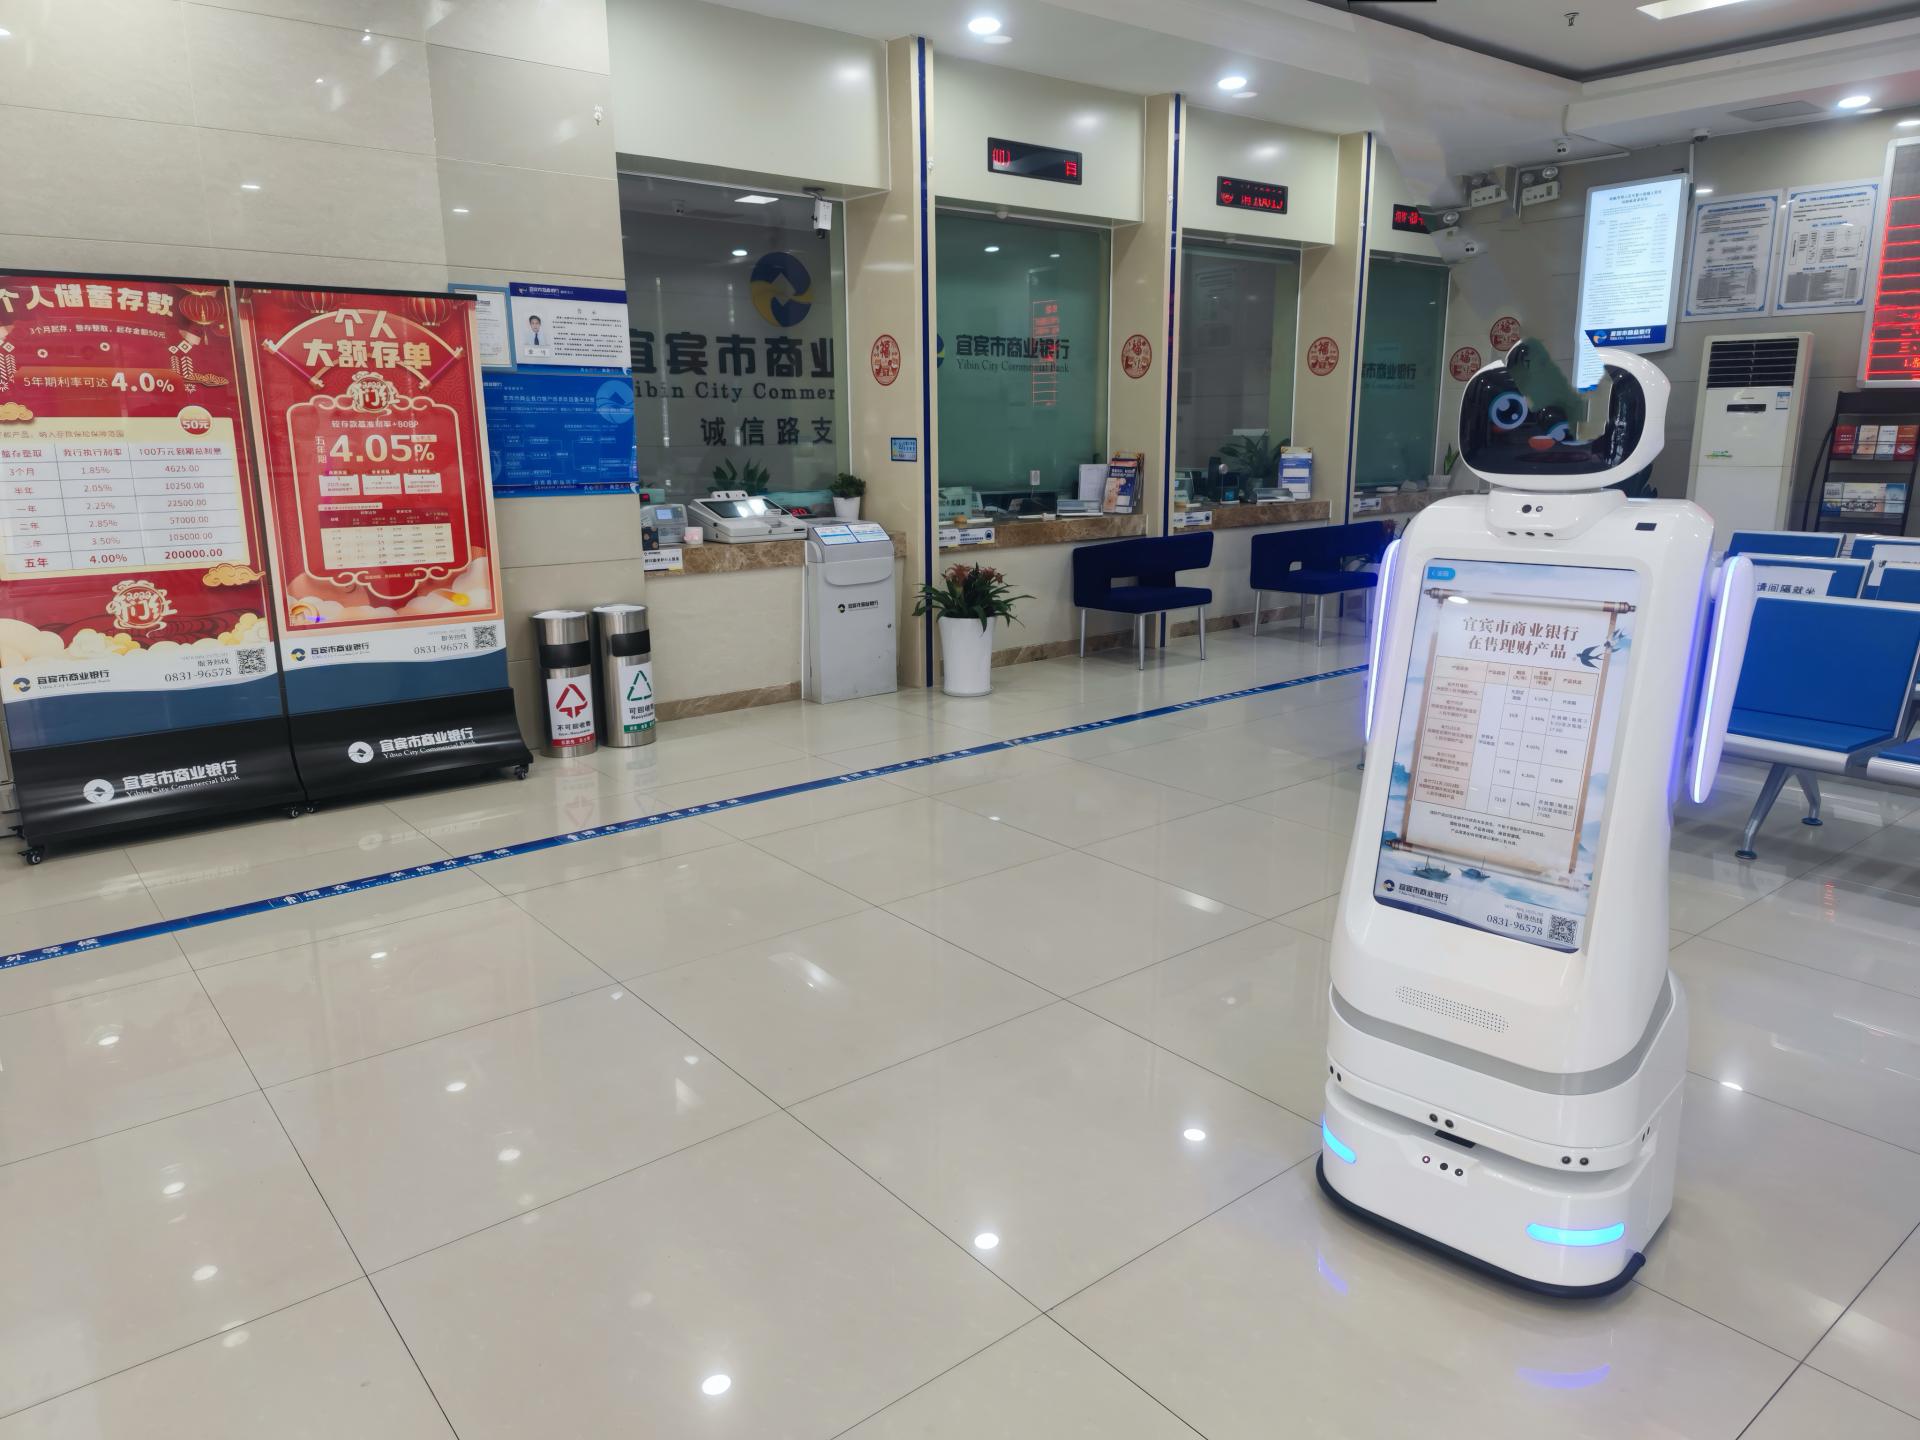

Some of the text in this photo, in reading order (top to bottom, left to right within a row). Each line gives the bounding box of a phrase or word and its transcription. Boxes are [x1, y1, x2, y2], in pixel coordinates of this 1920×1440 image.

[0, 284, 174, 317] 个人储蓄存款
[335, 309, 396, 338] 个人
[303, 338, 431, 369] 大额存单
[956, 334, 1069, 359] 宜宾市商业银行
[981, 359, 998, 372] City
[23, 371, 175, 392] 5年期利率可达 4.0%
[695, 382, 743, 402] City
[183, 420, 209, 429] 50元
[700, 417, 832, 447] 诚信路支
[330, 434, 435, 462] 4.05%
[9, 467, 35, 477] 3个月
[81, 466, 111, 475] 1.85%
[165, 465, 200, 473] 4625.00
[165, 482, 204, 490] 10250.00
[86, 502, 115, 510] 2.25%
[89, 520, 118, 528] 2.85%
[92, 537, 120, 545] 3.50%
[89, 554, 128, 564] 4.00%
[164, 548, 223, 560] 200000.00
[24, 558, 49, 568] 五年
[1463, 616, 1579, 641] 宜宾市商业银行
[1469, 635, 1567, 659] 在售理财产品
[37, 670, 110, 685] 宜宾市商业银行
[164, 668, 232, 683] 0831-96578
[379, 727, 474, 753] 宜宾市商业银行
[122, 760, 237, 790] 宜宾市商业银行
[151, 787, 169, 795] City
[171, 780, 219, 792] Commercial
[220, 774, 240, 784] Bank
[1486, 914, 1543, 936] 0831-96578
